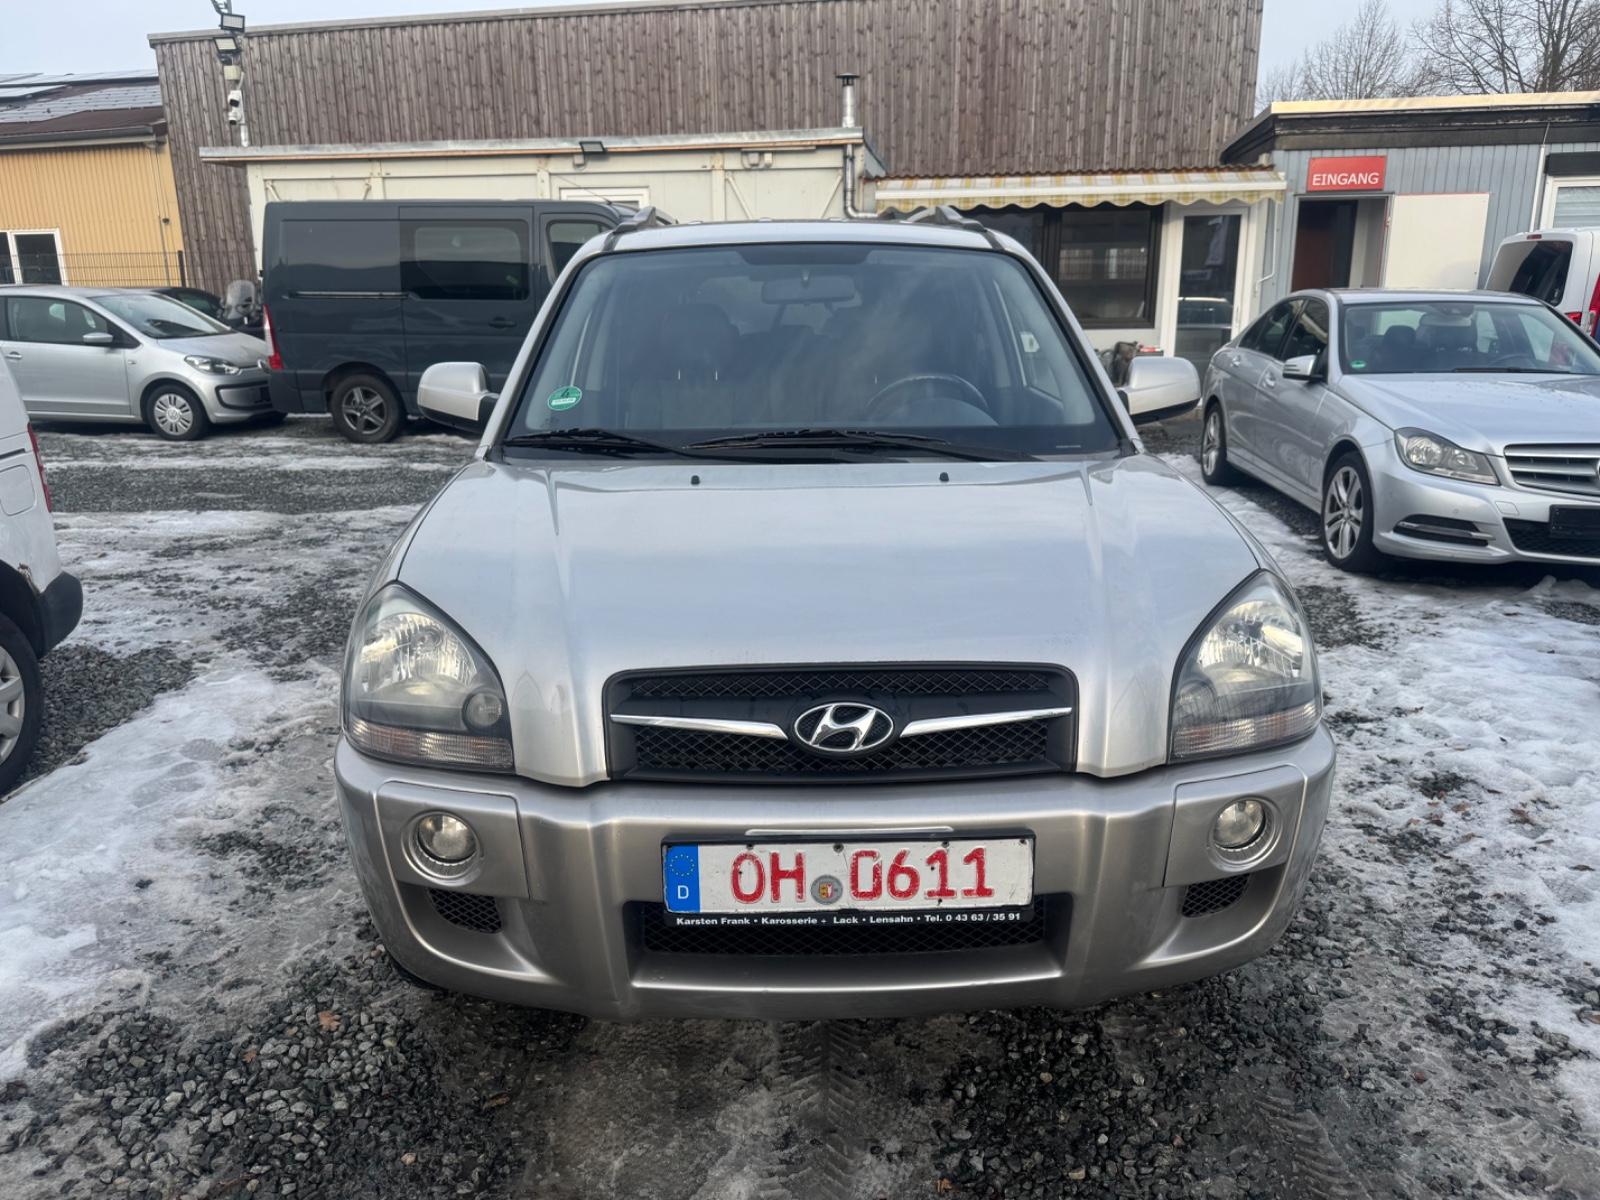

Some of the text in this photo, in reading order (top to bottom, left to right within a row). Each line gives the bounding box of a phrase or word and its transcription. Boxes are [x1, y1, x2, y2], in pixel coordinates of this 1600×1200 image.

[1312, 172, 1379, 186] EINGANG
[731, 846, 995, 904] OH 0611
[677, 885, 689, 899] D
[676, 917, 718, 925] Karsten
[721, 917, 750, 925] Frank
[761, 916, 818, 925] Karosserie
[833, 916, 859, 924] Lack
[869, 915, 914, 924] Lensahn
[924, 914, 943, 922] Tel.
[945, 914, 952, 922] 0
[955, 914, 968, 922] 43
[971, 913, 984, 921] 63
[992, 913, 1005, 921] 35
[1008, 912, 1021, 921] 91
